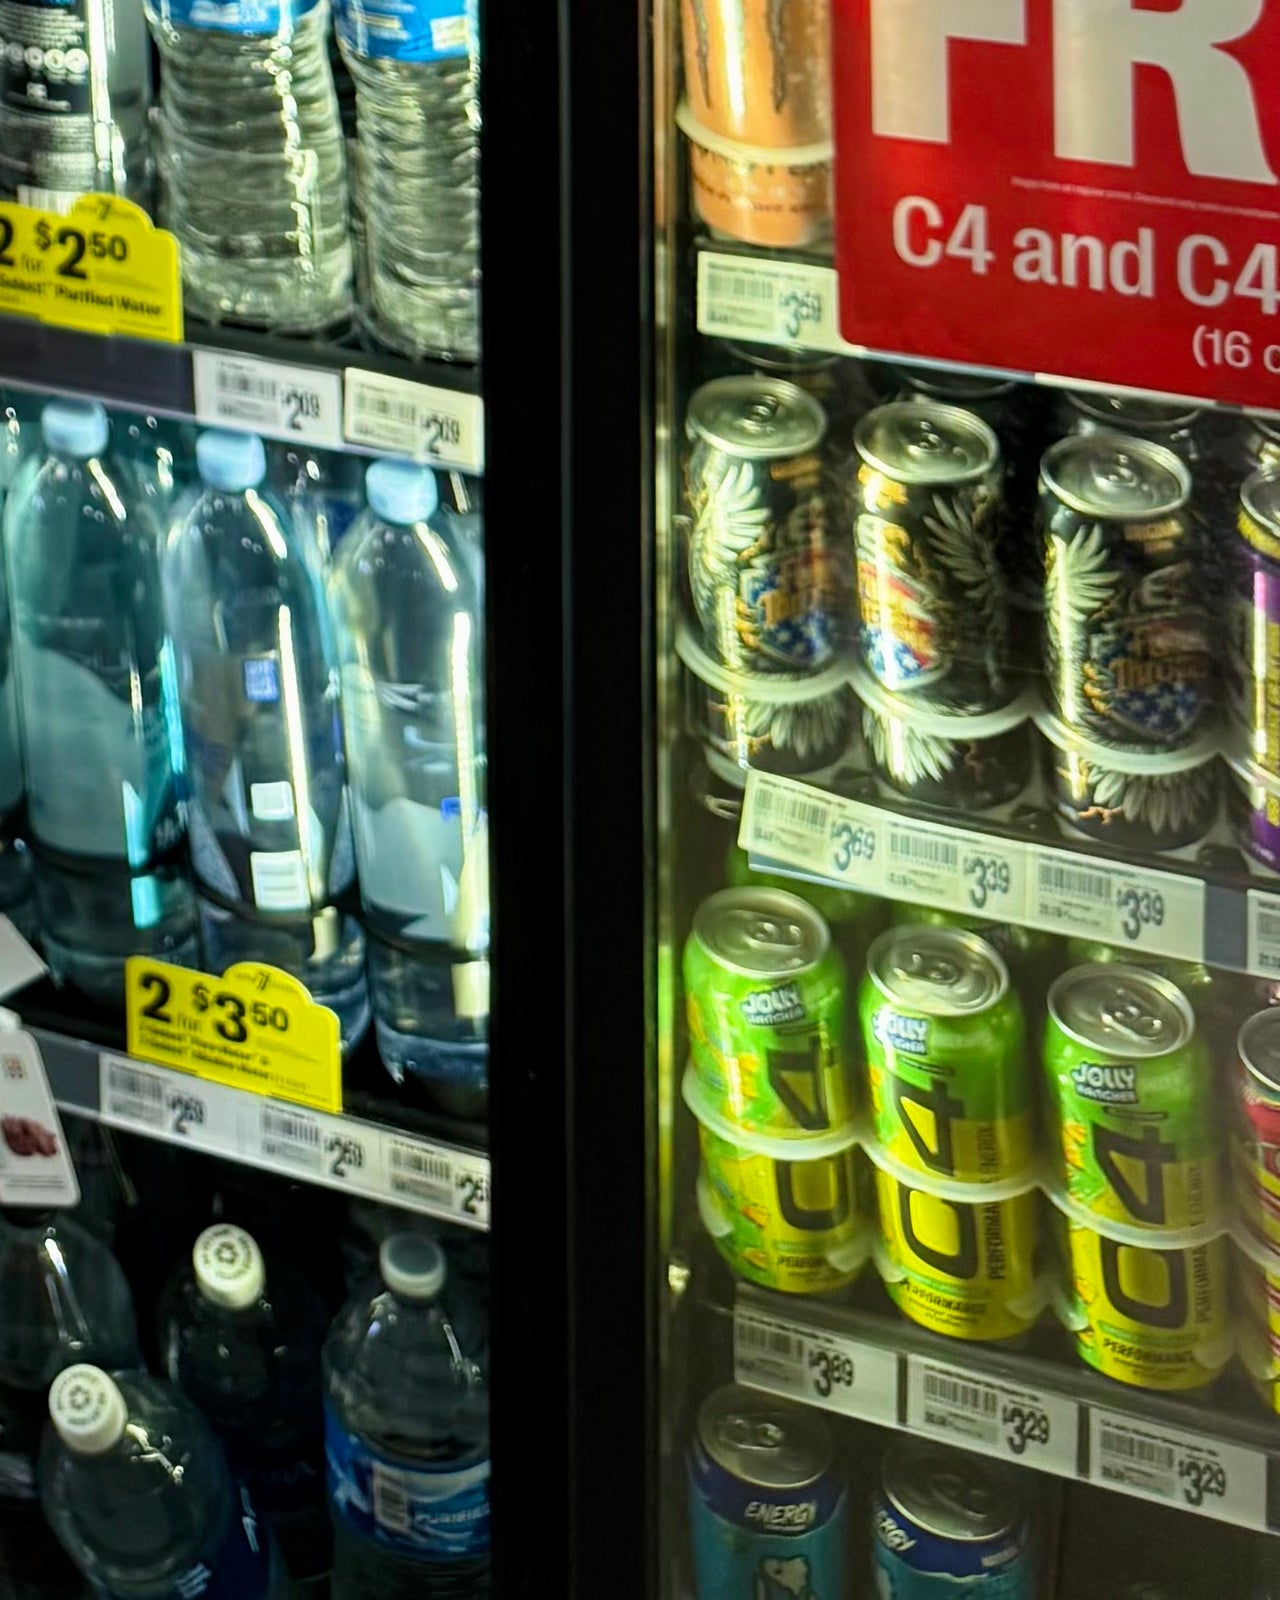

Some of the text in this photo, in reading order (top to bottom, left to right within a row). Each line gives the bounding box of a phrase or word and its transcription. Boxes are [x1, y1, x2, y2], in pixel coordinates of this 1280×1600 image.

[891, 195, 997, 276] C4
[1012, 226, 1155, 299] and
[1176, 233, 1280, 316] C4
[1192, 324, 1252, 369] (16
[141, 973, 172, 1024] 2
[746, 986, 801, 1015] JOLLY
[1072, 1063, 1135, 1089] JOLLY
[744, 1501, 817, 1525] ENERGY
